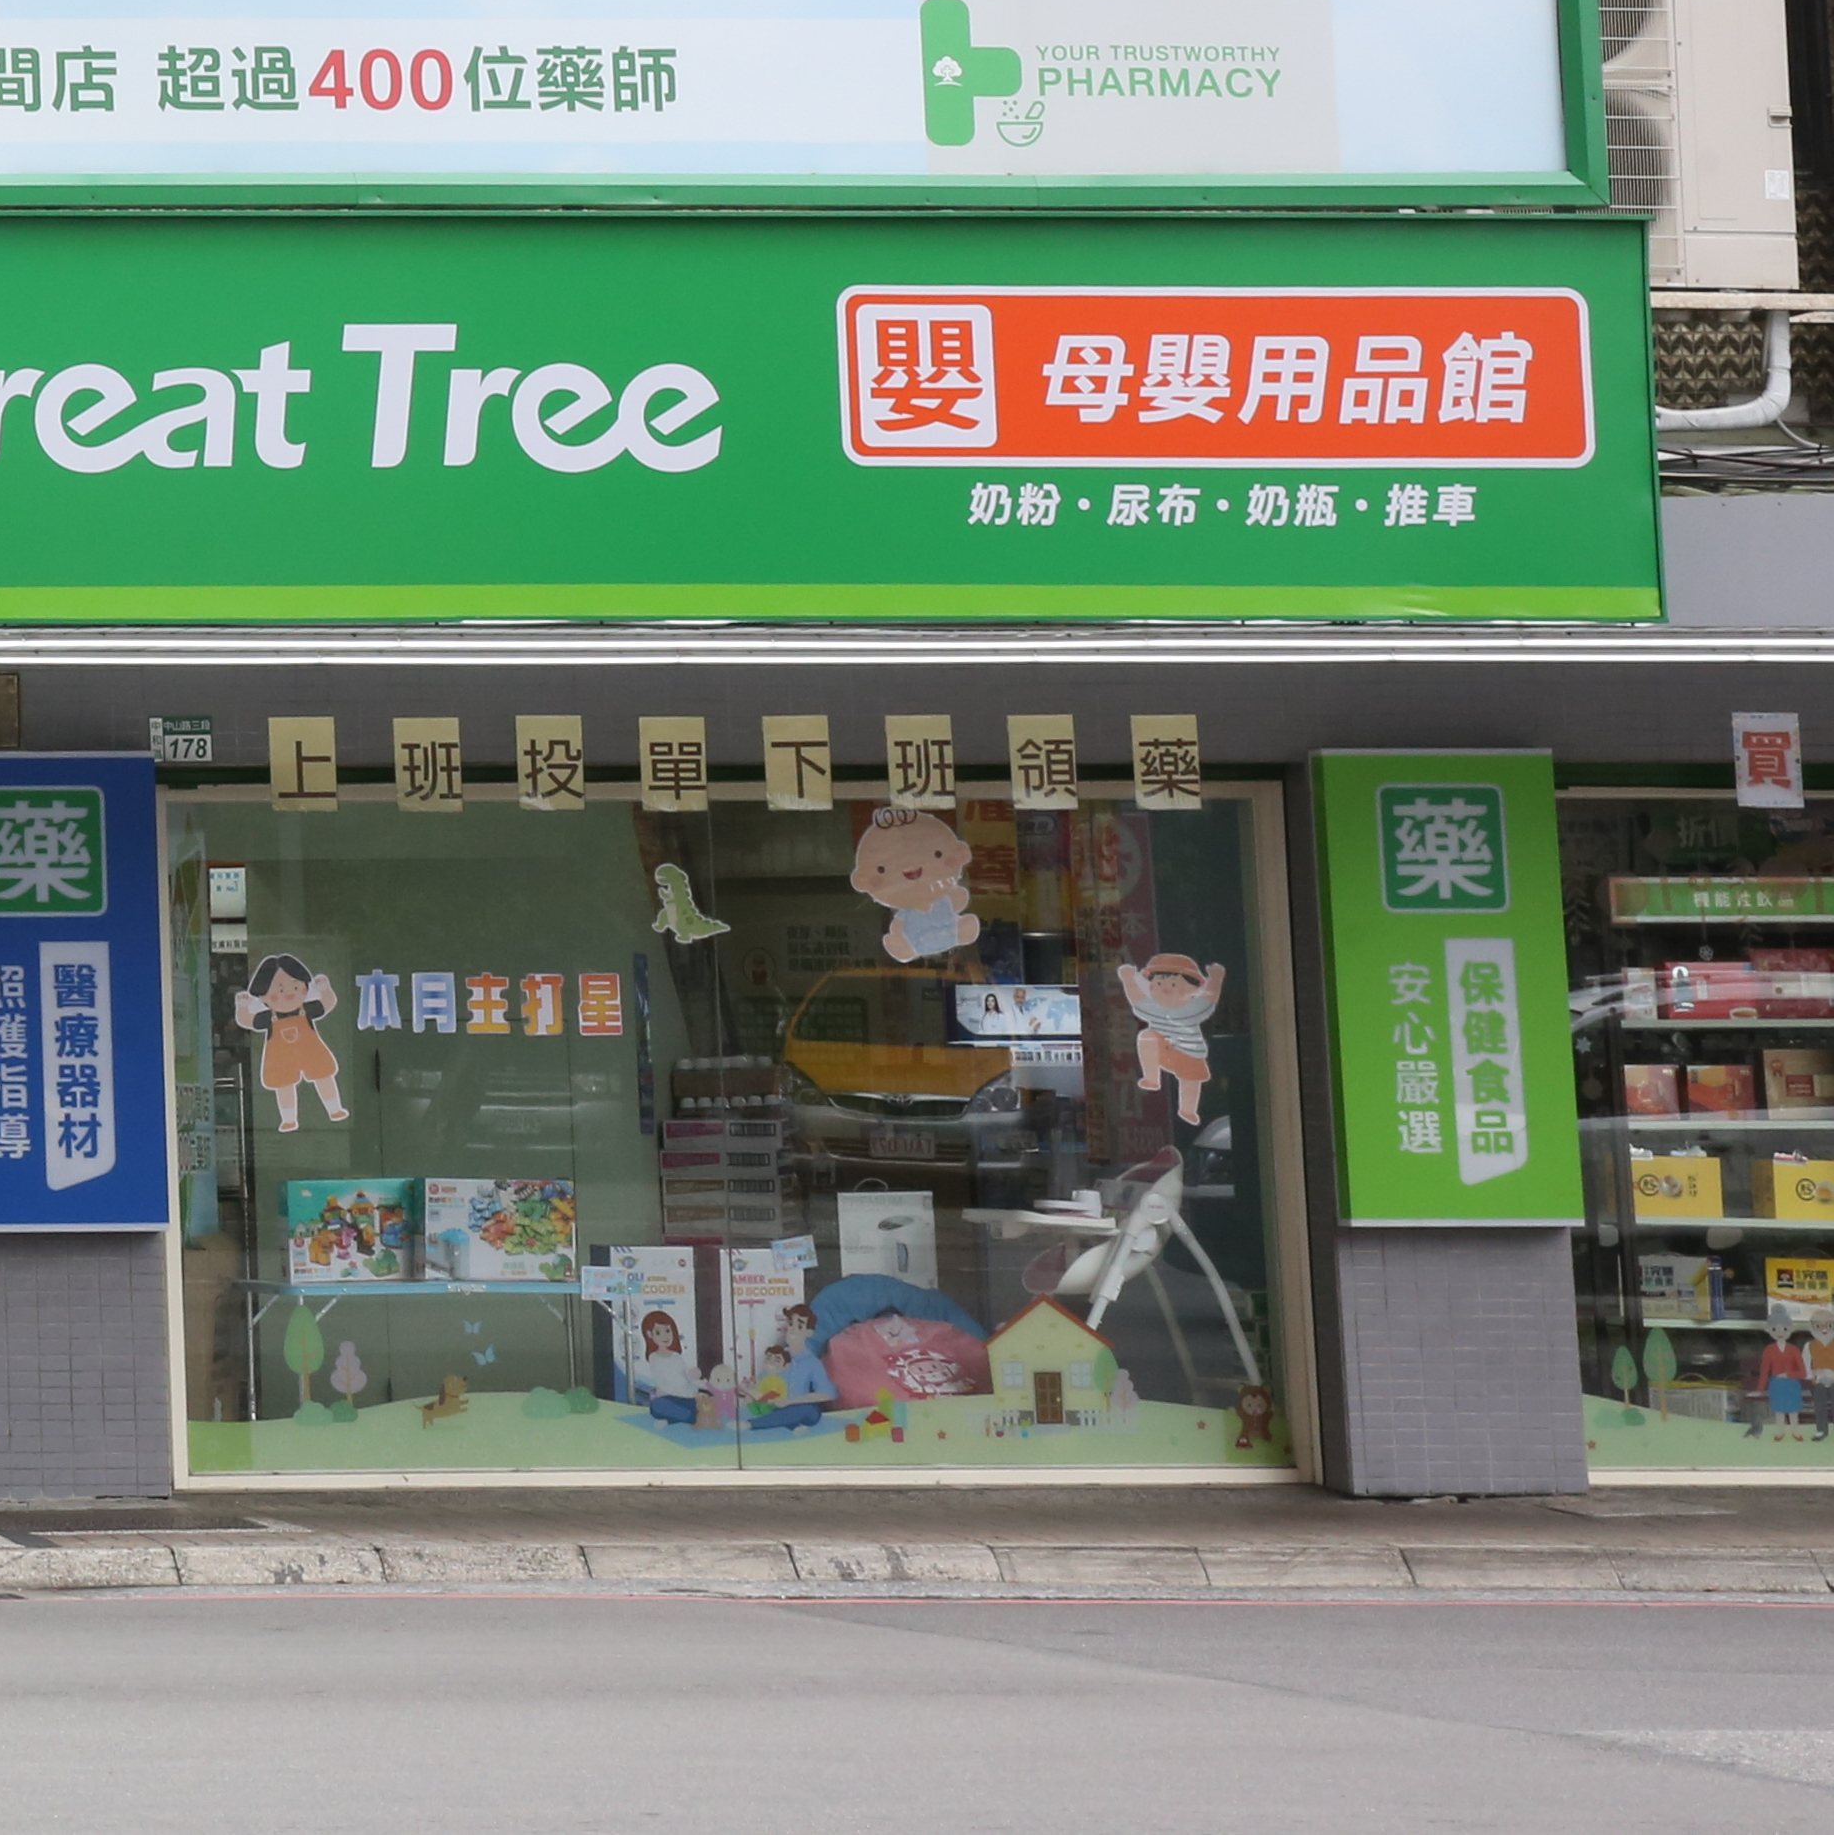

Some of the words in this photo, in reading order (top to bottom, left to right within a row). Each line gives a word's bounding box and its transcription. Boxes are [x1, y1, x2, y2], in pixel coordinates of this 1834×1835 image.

[157, 44, 680, 114] 超過400位藥師
[1035, 44, 1104, 63] YOUR
[1110, 44, 1282, 63] TRUSTWORTHY
[1037, 67, 1282, 99] PHARMACY
[339, 322, 724, 475] Tree
[869, 318, 985, 433] 嬰
[1041, 331, 1536, 427] 母嬰用品館
[163, 719, 211, 732] 中山路三段
[169, 738, 208, 759] 178
[1741, 731, 1793, 789] 買
[1392, 798, 1493, 900] 藥
[355, 969, 623, 1036] 本月主打星
[53, 962, 102, 1162] 醫療器材
[1388, 961, 1444, 1155] 安心嚴選
[1459, 959, 1515, 1155] 保健食品
[641, 1284, 686, 1295] COOTER
